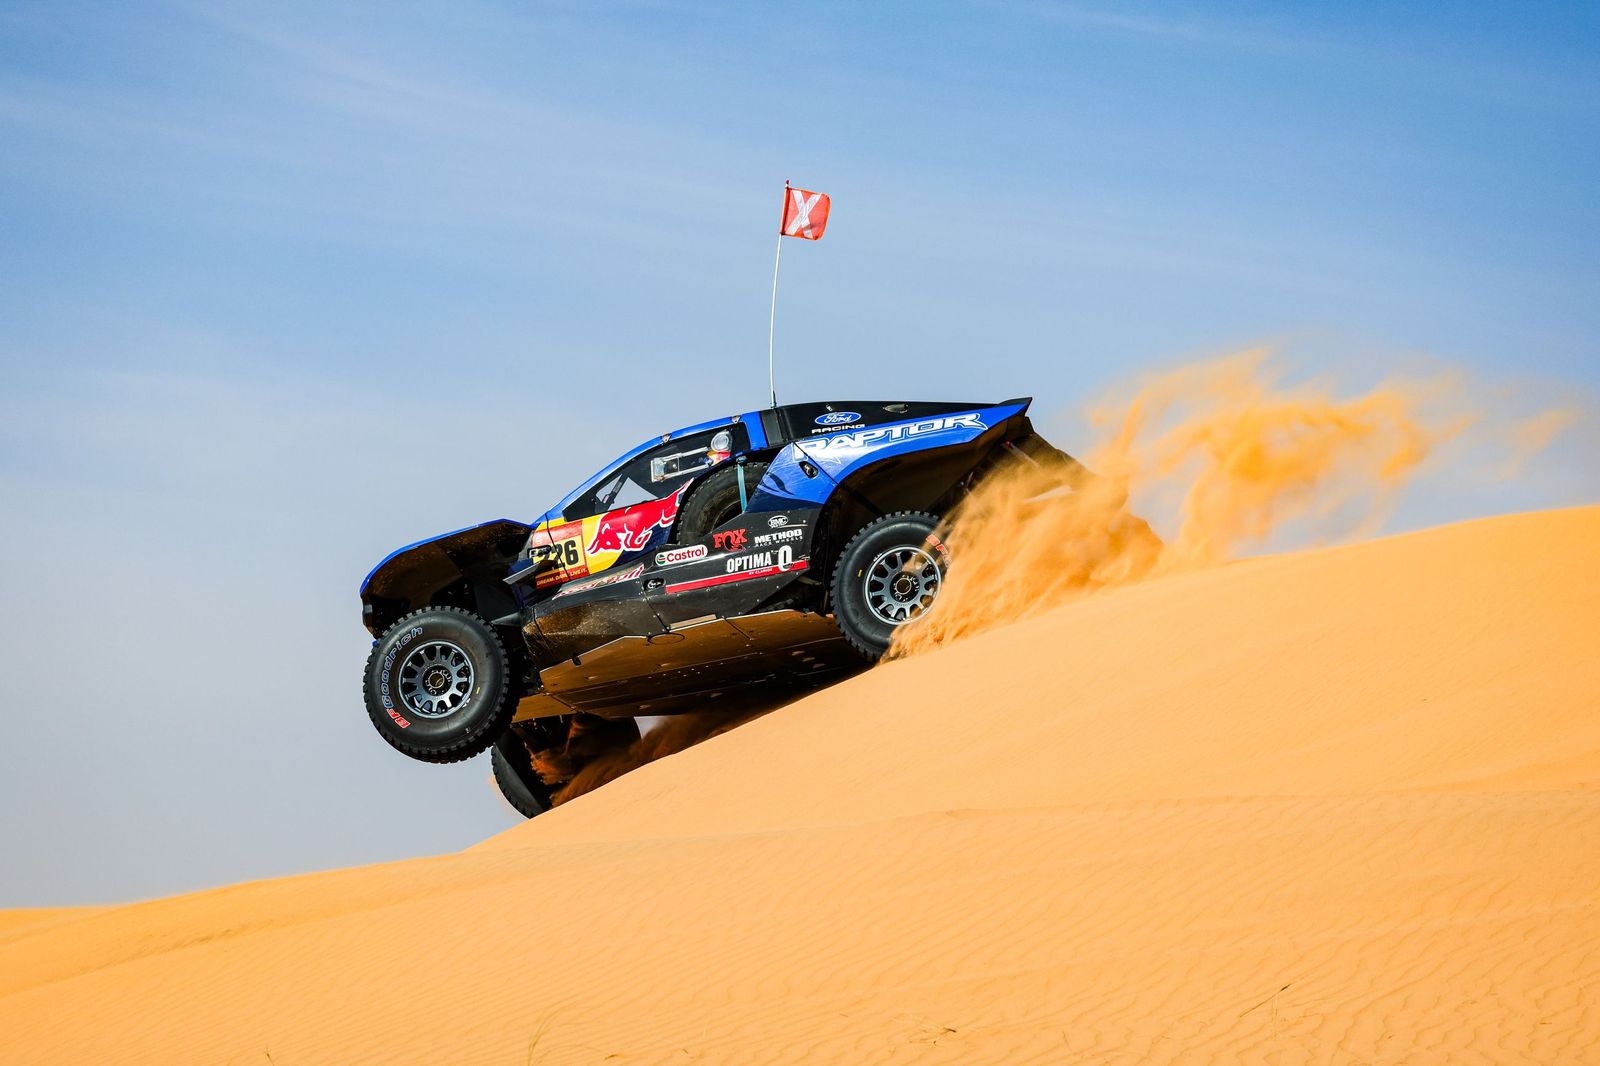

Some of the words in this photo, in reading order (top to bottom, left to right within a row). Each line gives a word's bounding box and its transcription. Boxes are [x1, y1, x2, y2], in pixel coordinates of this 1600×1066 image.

[792, 412, 989, 464] RAPTOR
[811, 424, 866, 434] RACING
[712, 528, 748, 552] FOX
[754, 528, 803, 544] METHOD
[666, 546, 705, 563] Castrol
[726, 551, 772, 573] OPTIMA
